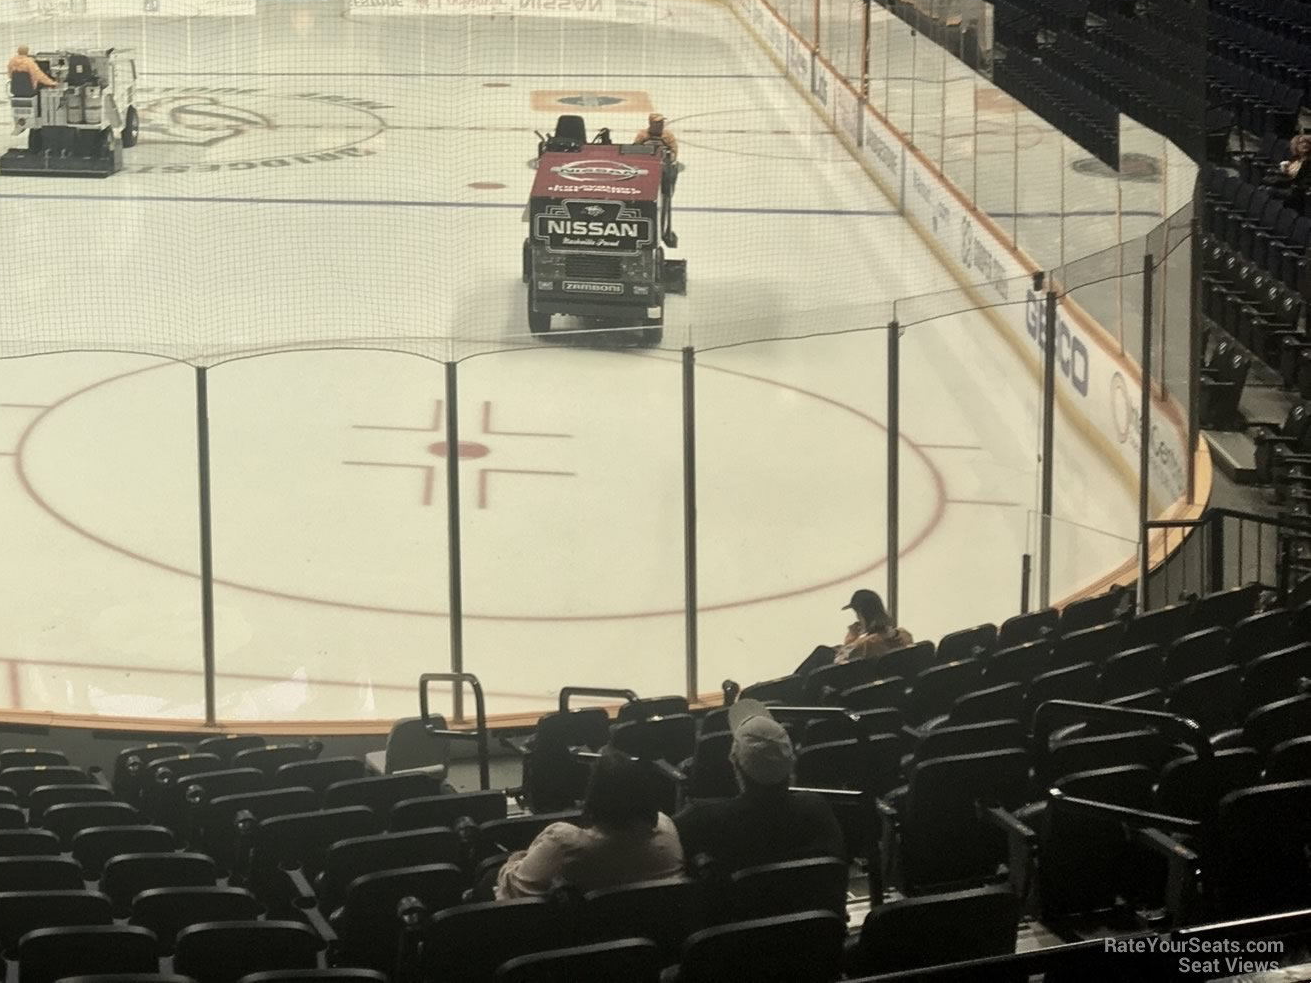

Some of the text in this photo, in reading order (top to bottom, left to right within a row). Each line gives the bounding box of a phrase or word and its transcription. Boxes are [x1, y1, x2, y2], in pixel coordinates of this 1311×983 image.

[560, 168, 639, 176] NISSAN
[547, 220, 638, 238] NISSAN
[565, 283, 621, 292] ZAMBONI
